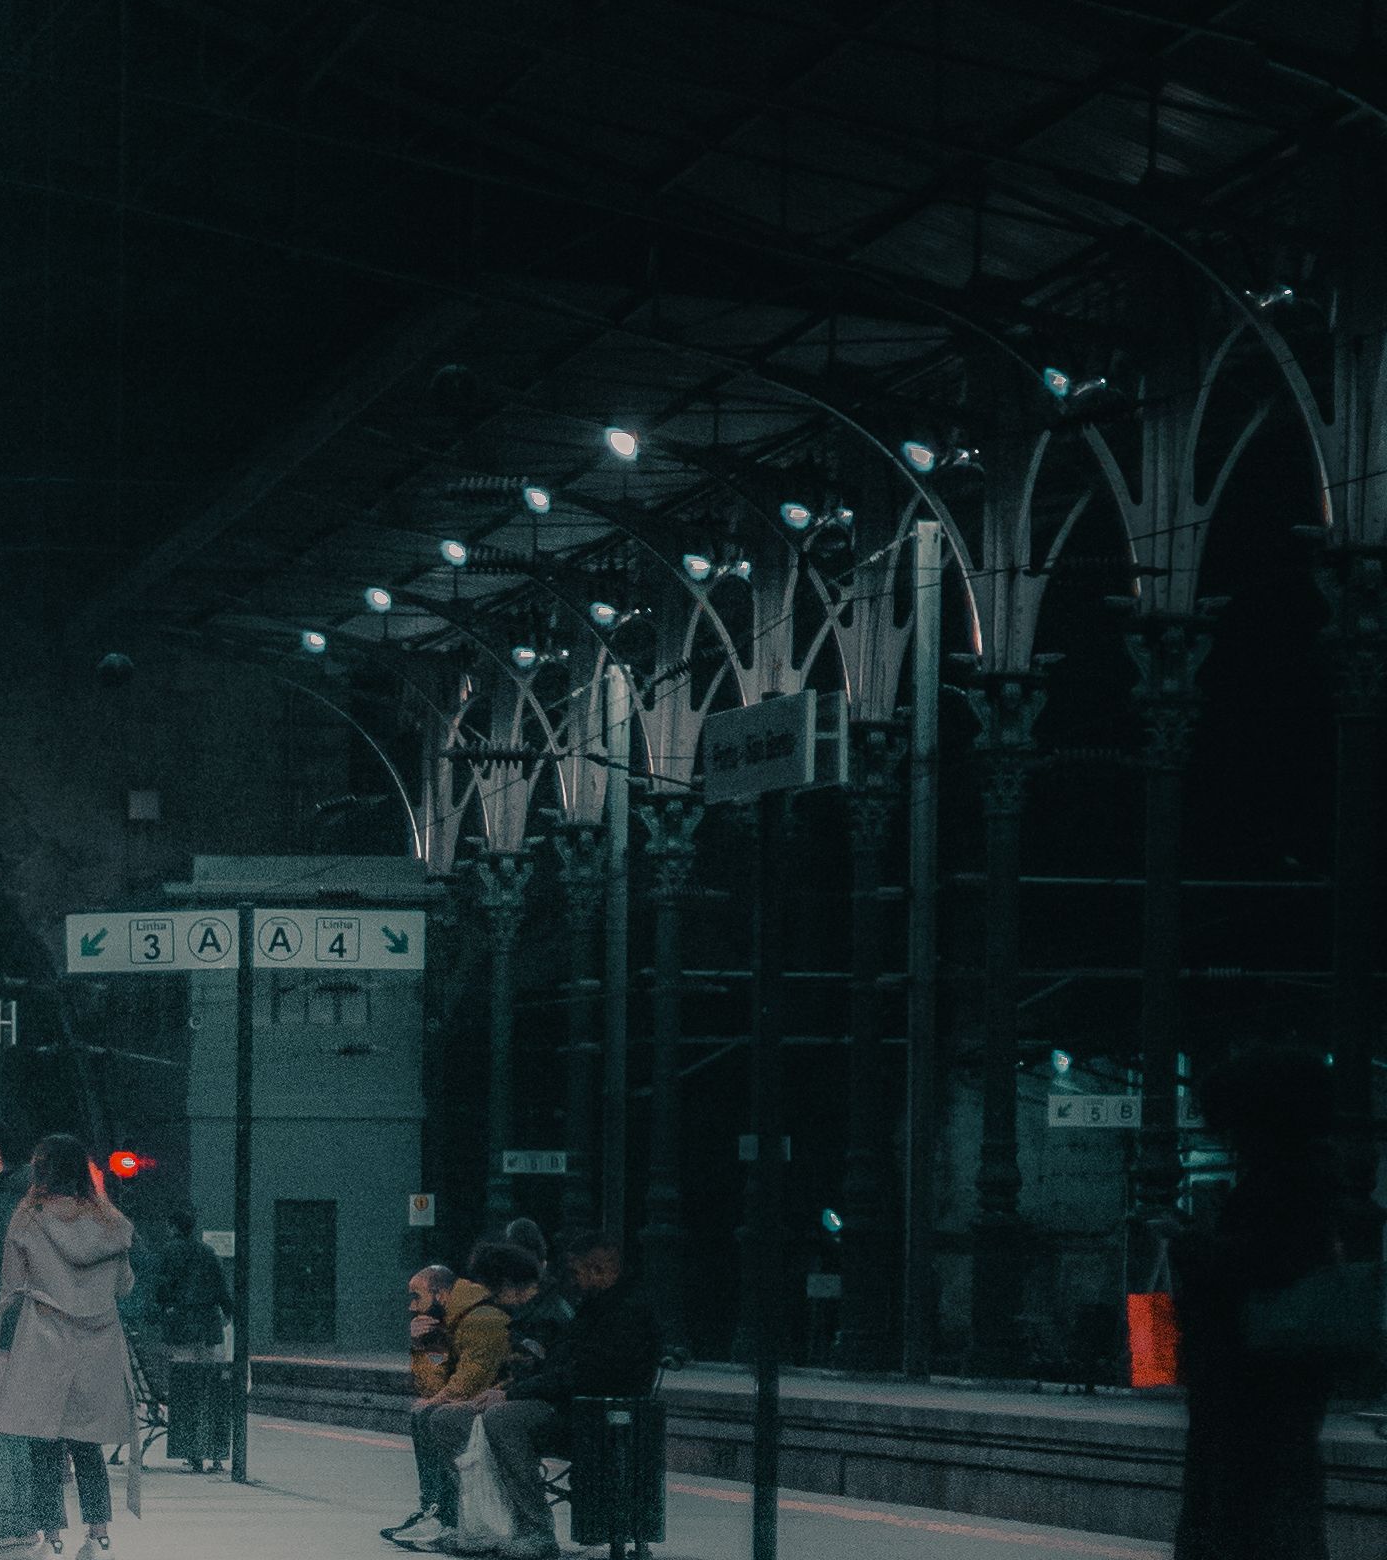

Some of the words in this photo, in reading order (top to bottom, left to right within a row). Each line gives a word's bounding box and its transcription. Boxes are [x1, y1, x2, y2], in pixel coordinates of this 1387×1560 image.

[136, 920, 167, 931] Linha
[322, 919, 353, 929] Linha
[144, 934, 161, 959] 3
[198, 927, 222, 953] A
[268, 926, 292, 952] A
[328, 932, 347, 958] 4
[1091, 1107, 1101, 1121] 5
[1120, 1105, 1132, 1119] B
